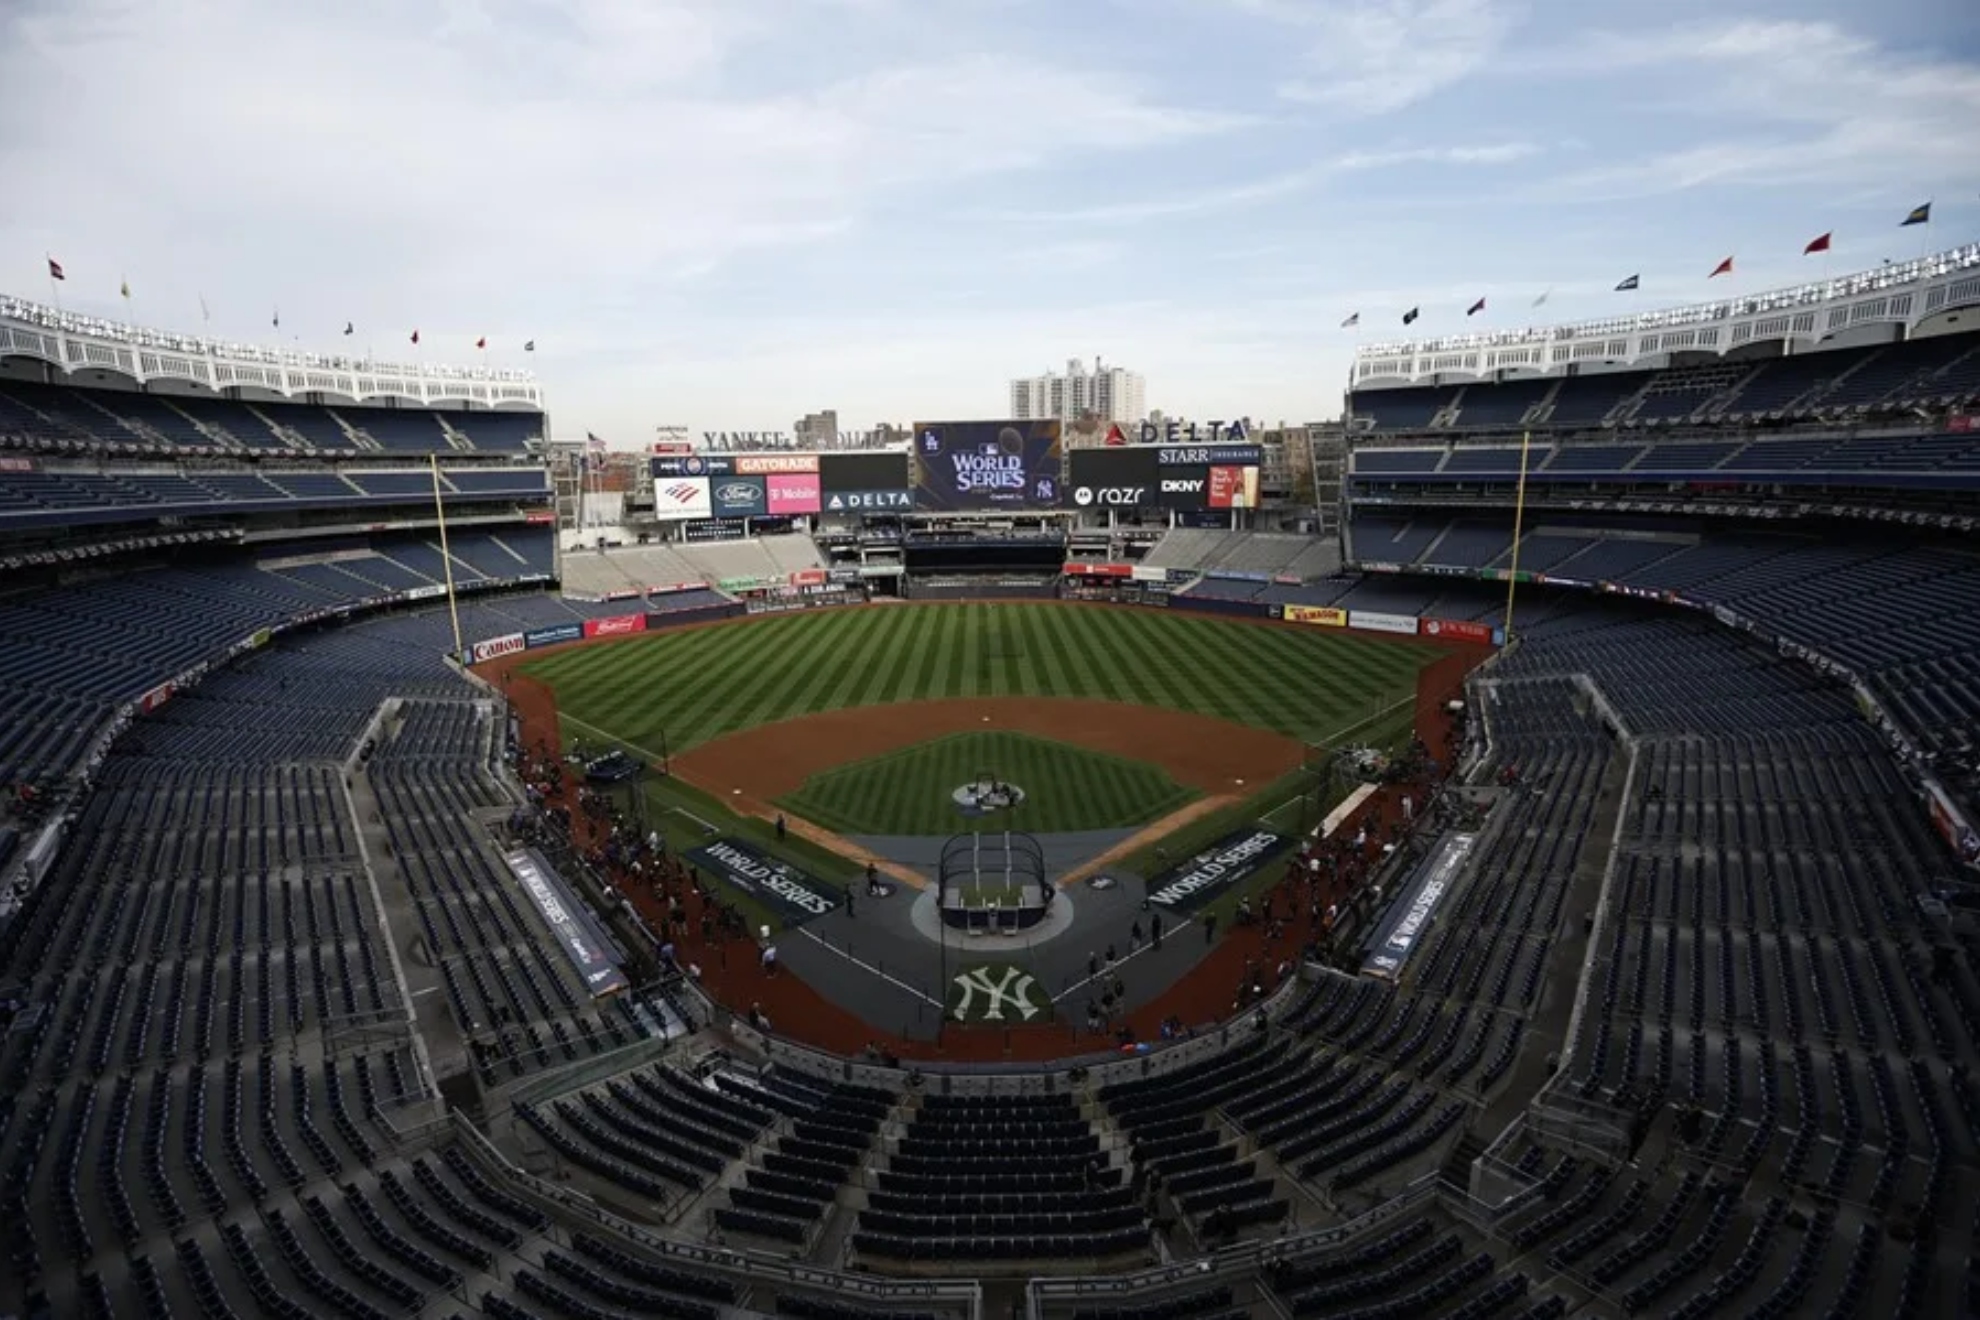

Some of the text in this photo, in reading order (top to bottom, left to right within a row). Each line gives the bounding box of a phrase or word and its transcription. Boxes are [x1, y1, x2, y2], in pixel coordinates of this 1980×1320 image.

[1140, 420, 1246, 443] DELTA
[741, 457, 815, 470] GATORADE
[951, 453, 1021, 472] WORLD
[1159, 448, 1209, 463] STARR
[956, 470, 1026, 491] SERIES
[1161, 480, 1204, 493] DKNY
[722, 483, 755, 501] Ford
[848, 493, 911, 507] DELTA
[1096, 488, 1146, 504] razr
[474, 636, 524, 659] Canon
[705, 841, 771, 878] WORLD
[761, 874, 835, 914] SERIES
[1149, 863, 1227, 905] WORLD
[1214, 832, 1279, 867] SERIES
[953, 966, 1039, 1021] NY
